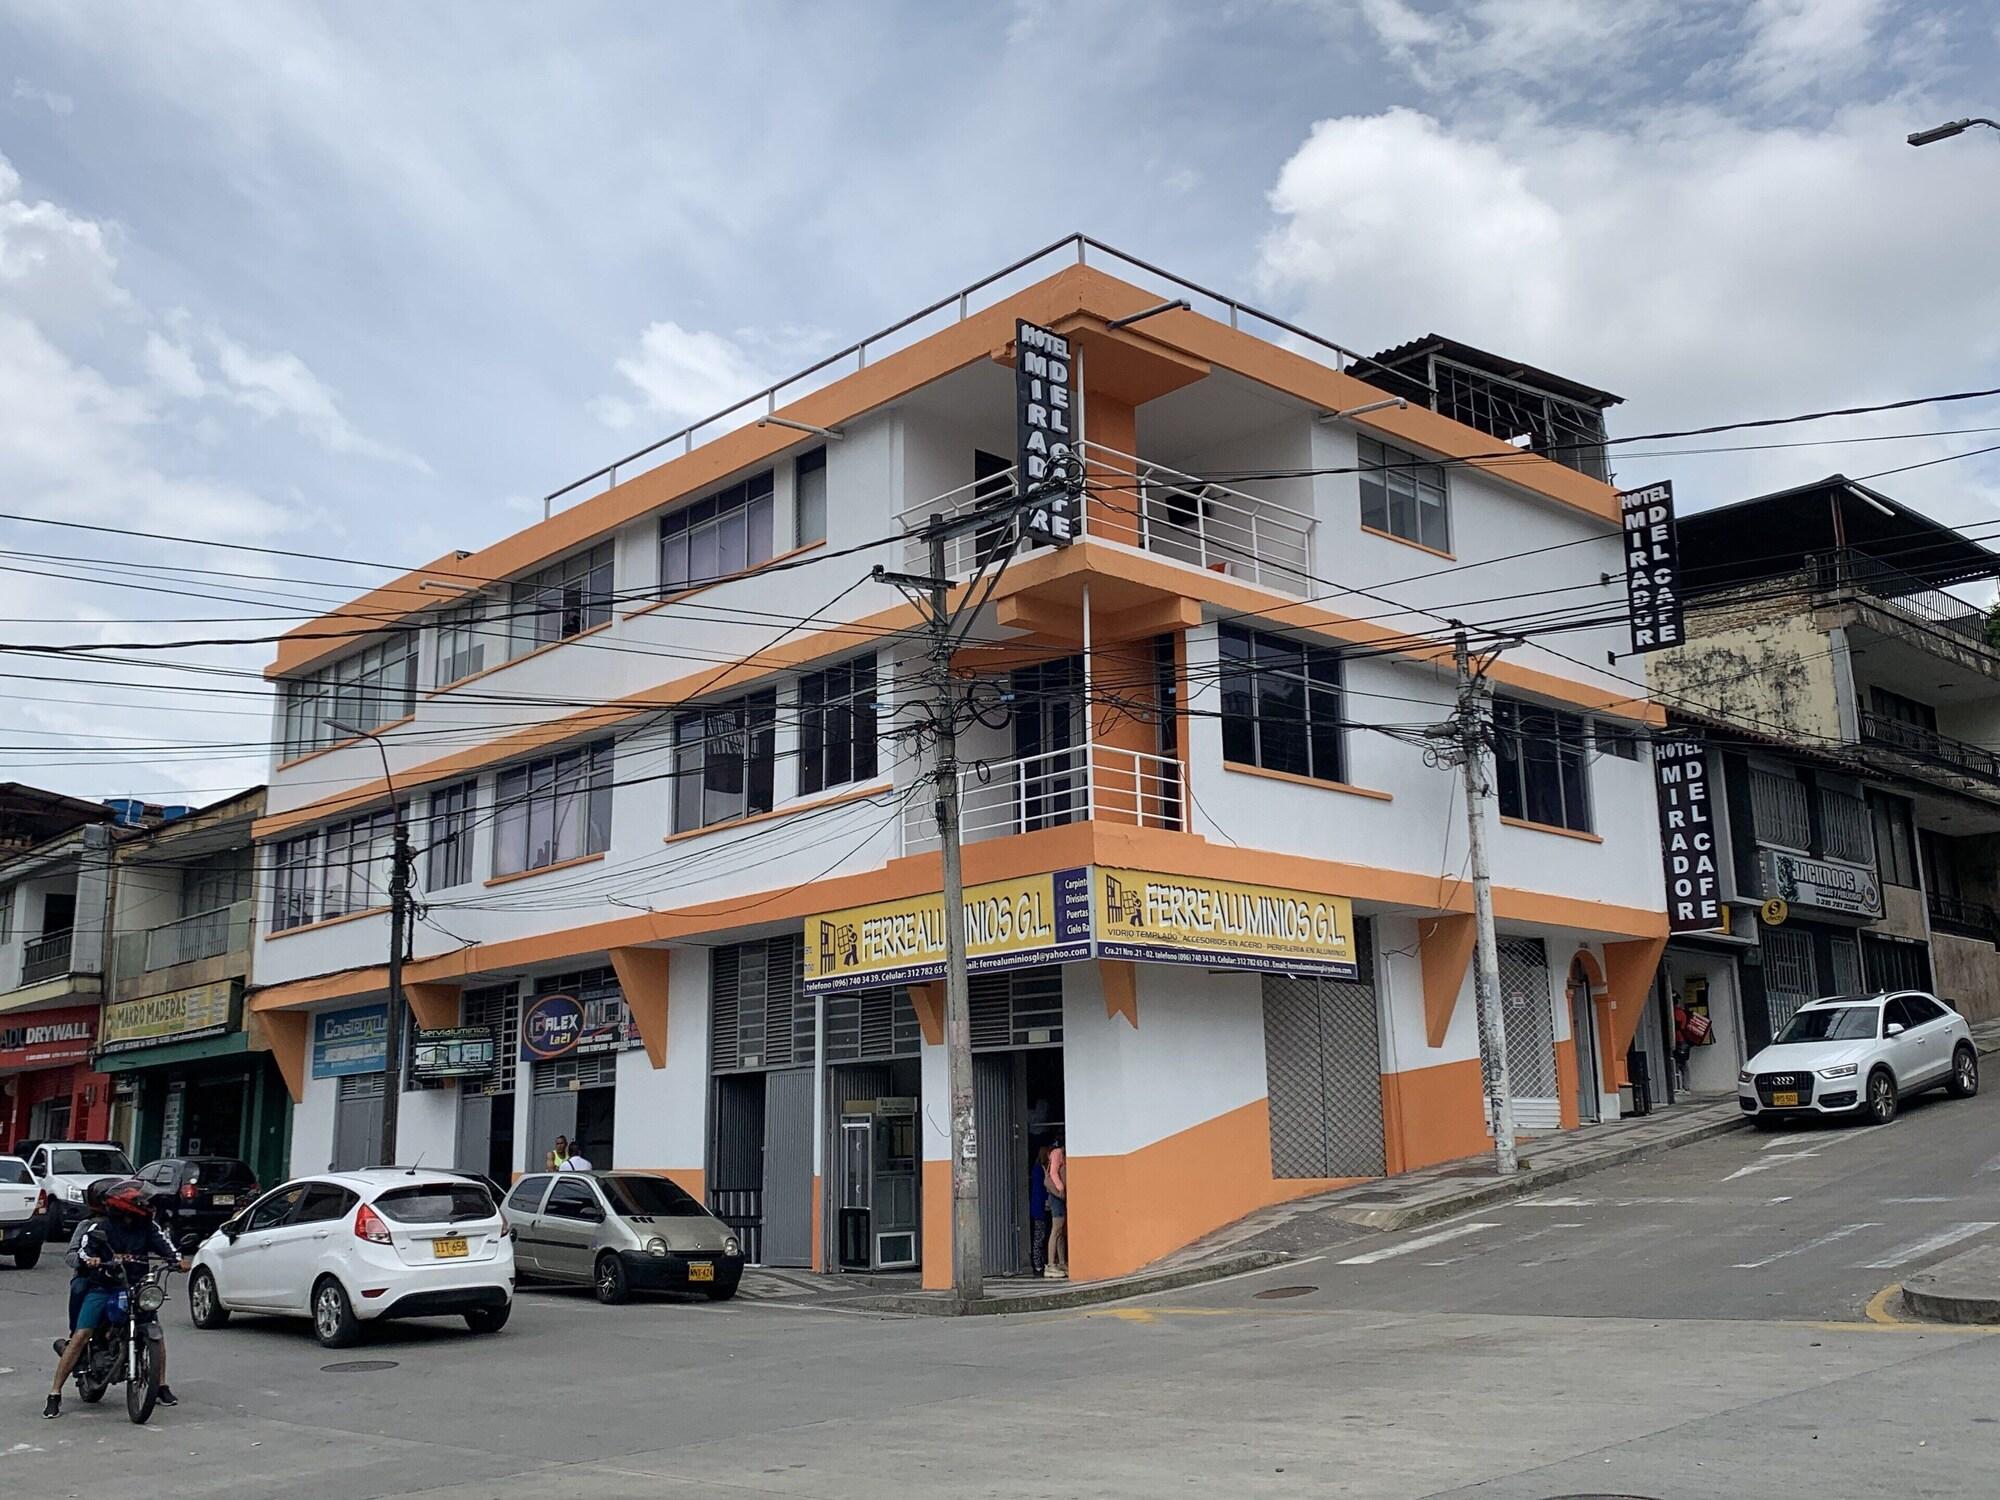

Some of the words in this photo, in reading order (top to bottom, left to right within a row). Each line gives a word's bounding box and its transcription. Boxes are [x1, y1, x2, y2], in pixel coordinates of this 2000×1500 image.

[1021, 324, 1071, 360] HOTEL
[1024, 351, 1049, 532] MIRADR
[1621, 485, 1670, 510] HOTEL
[1625, 510, 1655, 647] MIRADOR
[1655, 742, 1703, 761] HOTEL
[1661, 765, 1695, 921] MIRADOR
[1065, 878, 1088, 890] Carpint
[1067, 908, 1089, 919] Puertas
[1145, 883, 1311, 943] FERREALUMINIOS
[861, 896, 1013, 962] FERREALUINIOS
[1067, 922, 1082, 934] Cielo
[1107, 928, 1136, 938] VIDRIO
[1136, 931, 1178, 942] TEMPLADO
[1182, 935, 1228, 946] ACCESORIOS
[1239, 941, 1263, 950] ACERO
[1266, 943, 1305, 953] PERFILERIA
[1315, 948, 1346, 957] ALUMINIO
[1155, 951, 1177, 960] telefono
[806, 981, 832, 991] telefono
[832, 978, 849, 988] (096)
[849, 977, 861, 985] 740
[861, 976, 870, 984] 34
[881, 970, 907, 980] Celular:
[907, 969, 919, 978] 312
[920, 967, 933, 976] 782
[933, 966, 943, 974] 65
[117, 1003, 145, 1028] MAKRO
[146, 996, 187, 1024] MADERAS
[26, 1022, 90, 1044] DRYWALL
